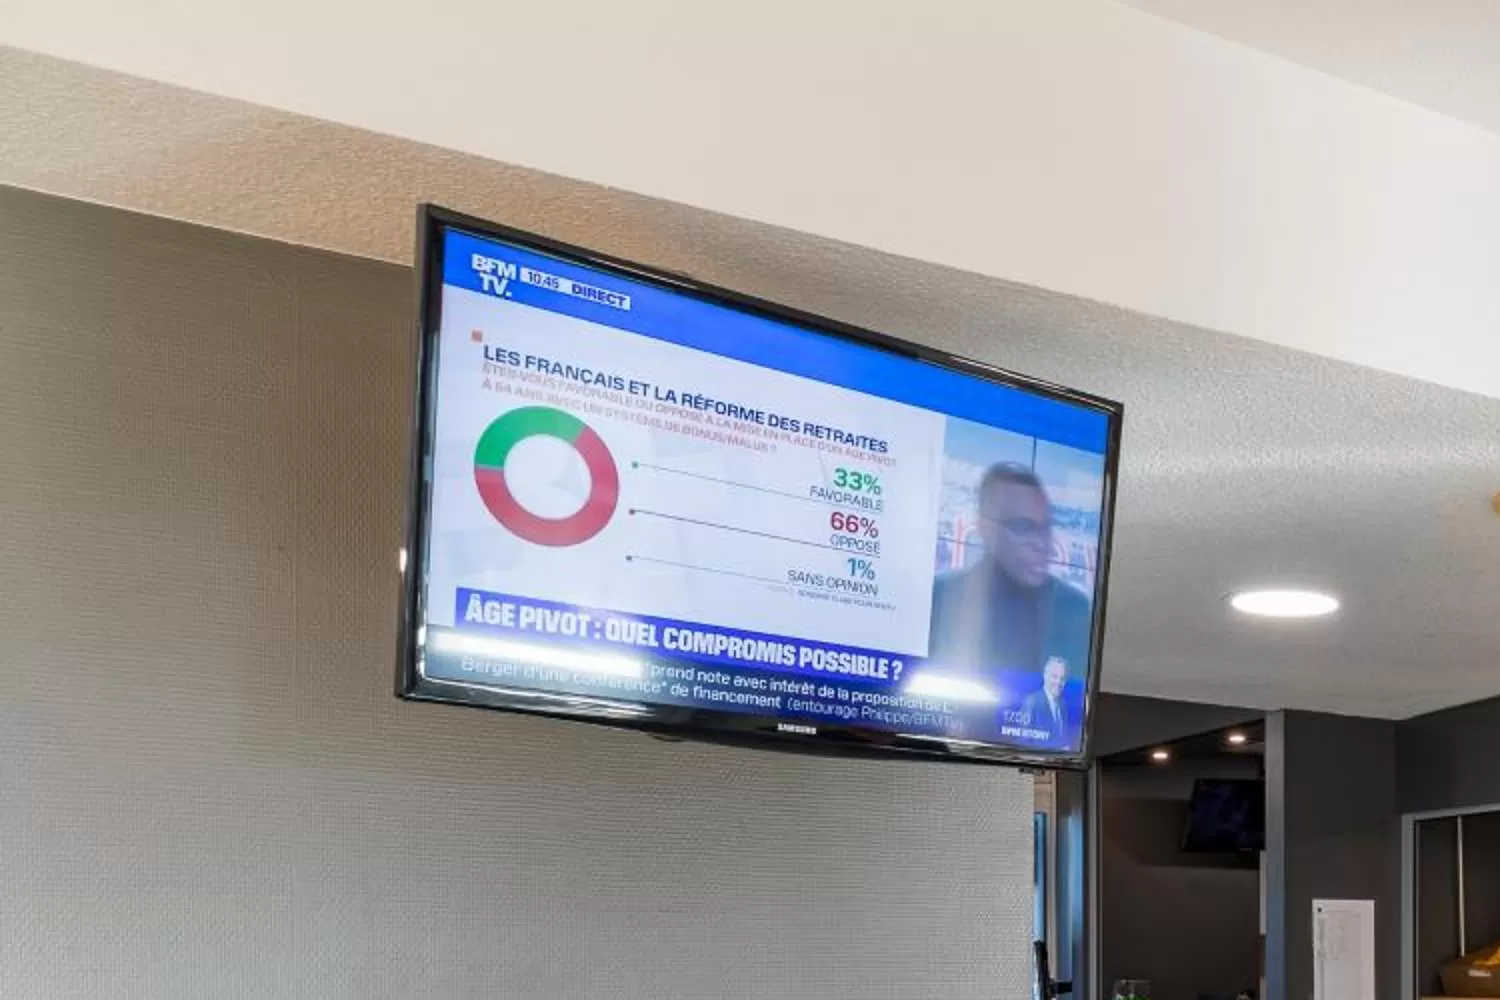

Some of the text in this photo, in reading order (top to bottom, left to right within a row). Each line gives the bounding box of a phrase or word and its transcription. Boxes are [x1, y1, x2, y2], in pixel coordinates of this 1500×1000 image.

[471, 253, 517, 281] BFM
[571, 283, 627, 308] DIRECT
[484, 345, 889, 453] LES FRANÇAIS ET LA RÉFORME DES RETRAITES
[834, 468, 882, 496] 33%
[810, 485, 883, 511] FAVORABLE
[831, 511, 879, 538] 66%
[848, 558, 875, 581] 1%
[788, 570, 878, 597] SANS OPINION
[465, 593, 515, 627] ÂGE
[519, 606, 591, 637] PIVOT
[605, 618, 658, 647] QUEL
[663, 627, 797, 667] COMPROMIS
[799, 651, 889, 680] POSSIBLE
[651, 664, 696, 681] prend
[697, 671, 731, 685] note
[733, 675, 767, 690] avec
[770, 677, 815, 696] intérêt
[818, 685, 835, 698] de
[837, 687, 849, 700] la
[670, 681, 688, 697] de
[693, 684, 781, 709] financement
[777, 722, 817, 735] SAMSUNG
